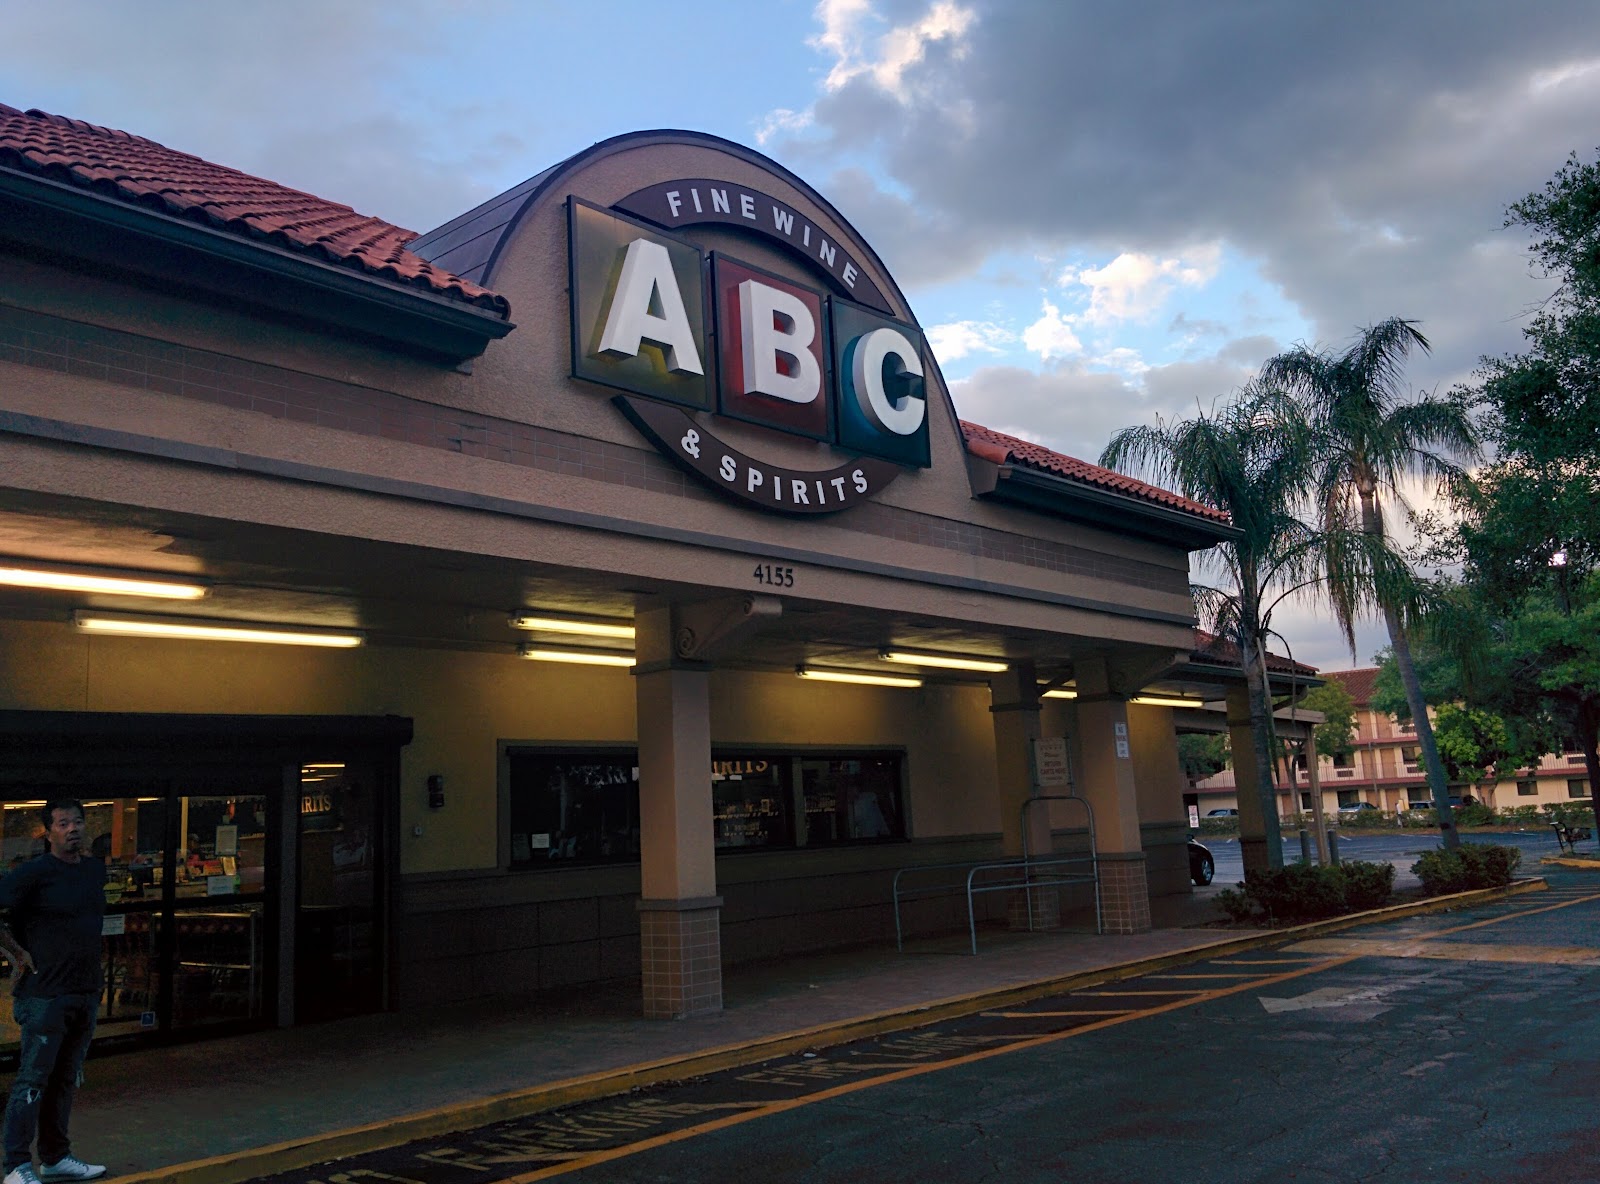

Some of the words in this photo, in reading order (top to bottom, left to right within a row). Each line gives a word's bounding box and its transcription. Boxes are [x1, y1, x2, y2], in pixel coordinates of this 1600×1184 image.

[666, 188, 757, 221] FINE
[772, 206, 859, 289] WINE
[597, 237, 925, 436] ABC
[680, 428, 701, 459] &
[719, 455, 869, 505] SPIRITS
[753, 563, 794, 588] 4155
